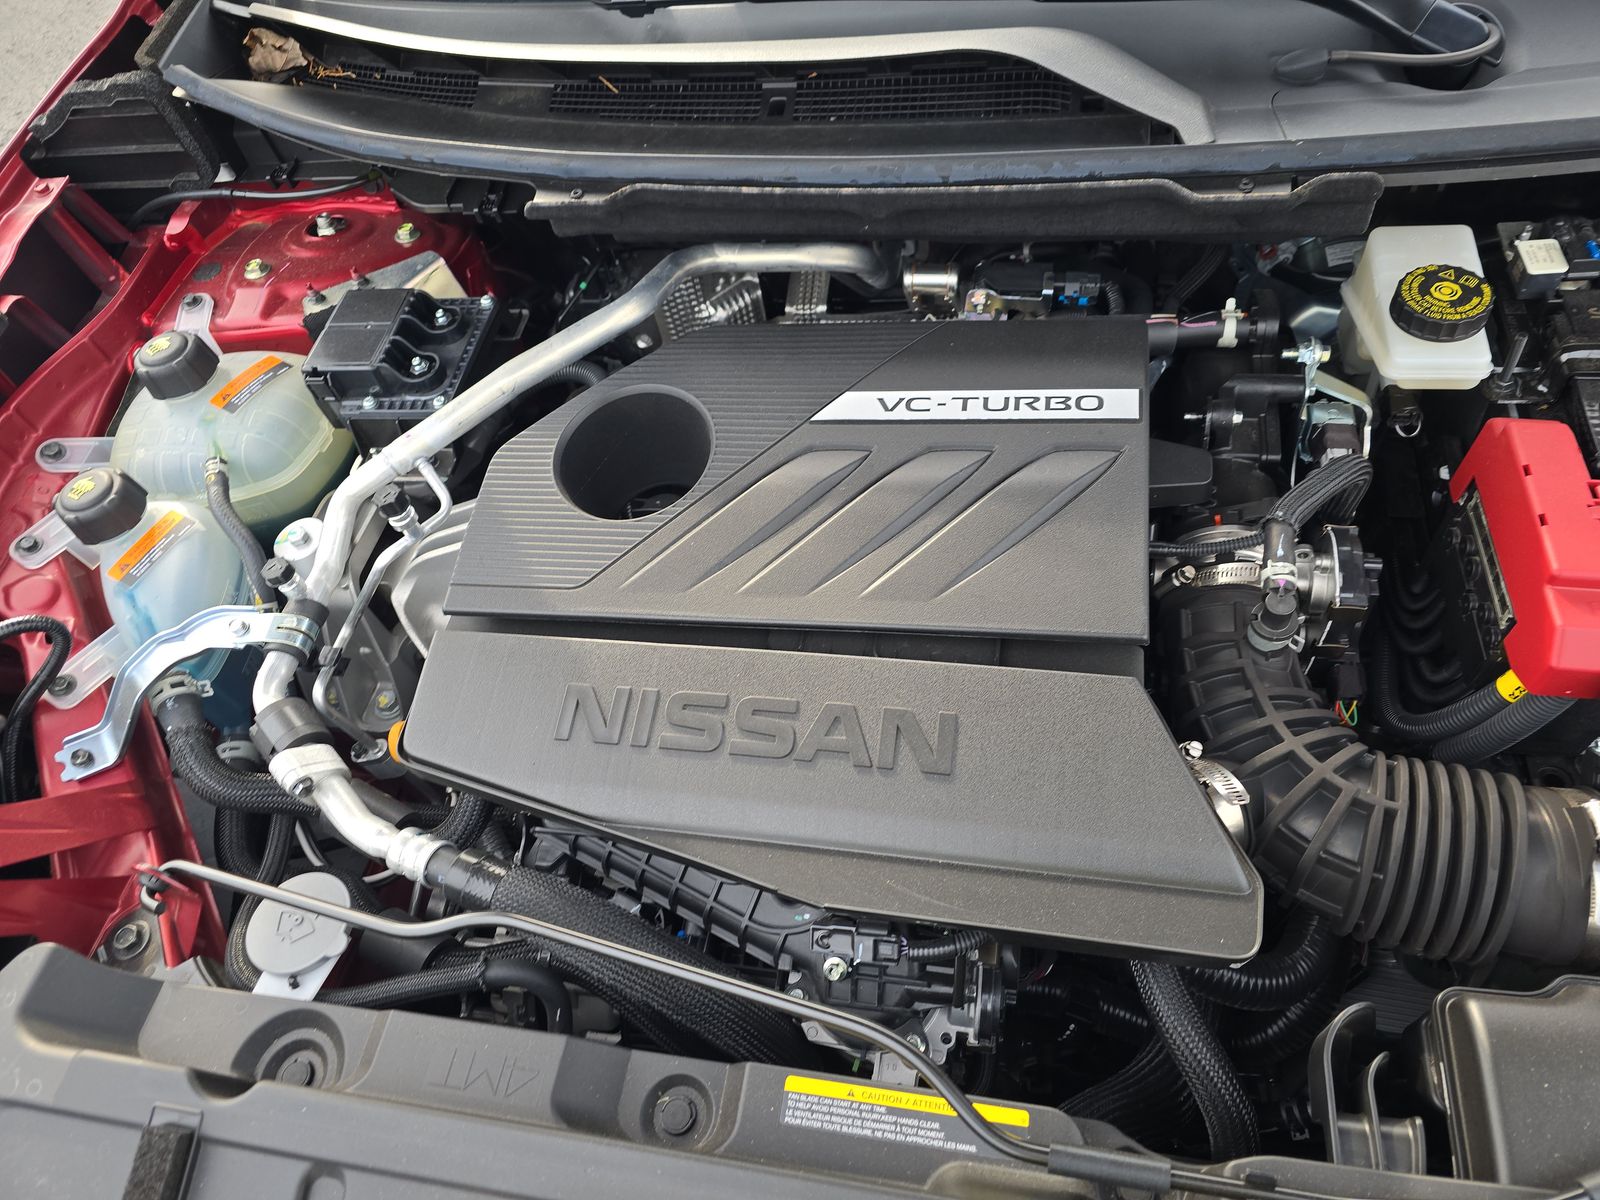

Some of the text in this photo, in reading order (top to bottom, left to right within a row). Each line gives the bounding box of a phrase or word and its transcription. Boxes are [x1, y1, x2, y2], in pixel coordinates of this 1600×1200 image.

[876, 394, 1105, 413] VC-TURBO
[553, 681, 959, 776] NISSAN
[788, 1092, 800, 1100] FAN
[800, 1094, 819, 1103] BLADE
[820, 1097, 832, 1105] CAN
[833, 1098, 851, 1108] START
[852, 1101, 859, 1109] AT
[860, 1102, 873, 1111] ANY
[861, 1091, 902, 1105] CAUTION
[912, 1098, 955, 1112] ATTENTI
[793, 1110, 831, 1121] VENTILATEUR
[831, 1114, 852, 1125] RISQUE
[853, 1118, 862, 1126] DE
[863, 1119, 896, 1131] DÉMARRER
[902, 1125, 918, 1135] TOUT
[796, 1102, 812, 1110] HELP
[811, 1104, 829, 1113] AVOID
[830, 1106, 860, 1118] PERSONAL
[897, 1116, 919, 1126] HANDS
[784, 1117, 801, 1125] POUR
[802, 1118, 821, 1128] ÉVITER
[822, 1121, 841, 1131] TOUTE
[874, 1129, 883, 1138] NE
[883, 1131, 896, 1141] PAS
[896, 1133, 906, 1141] EN
[905, 1135, 943, 1148] APPROCHER
[943, 1140, 956, 1149] LES
